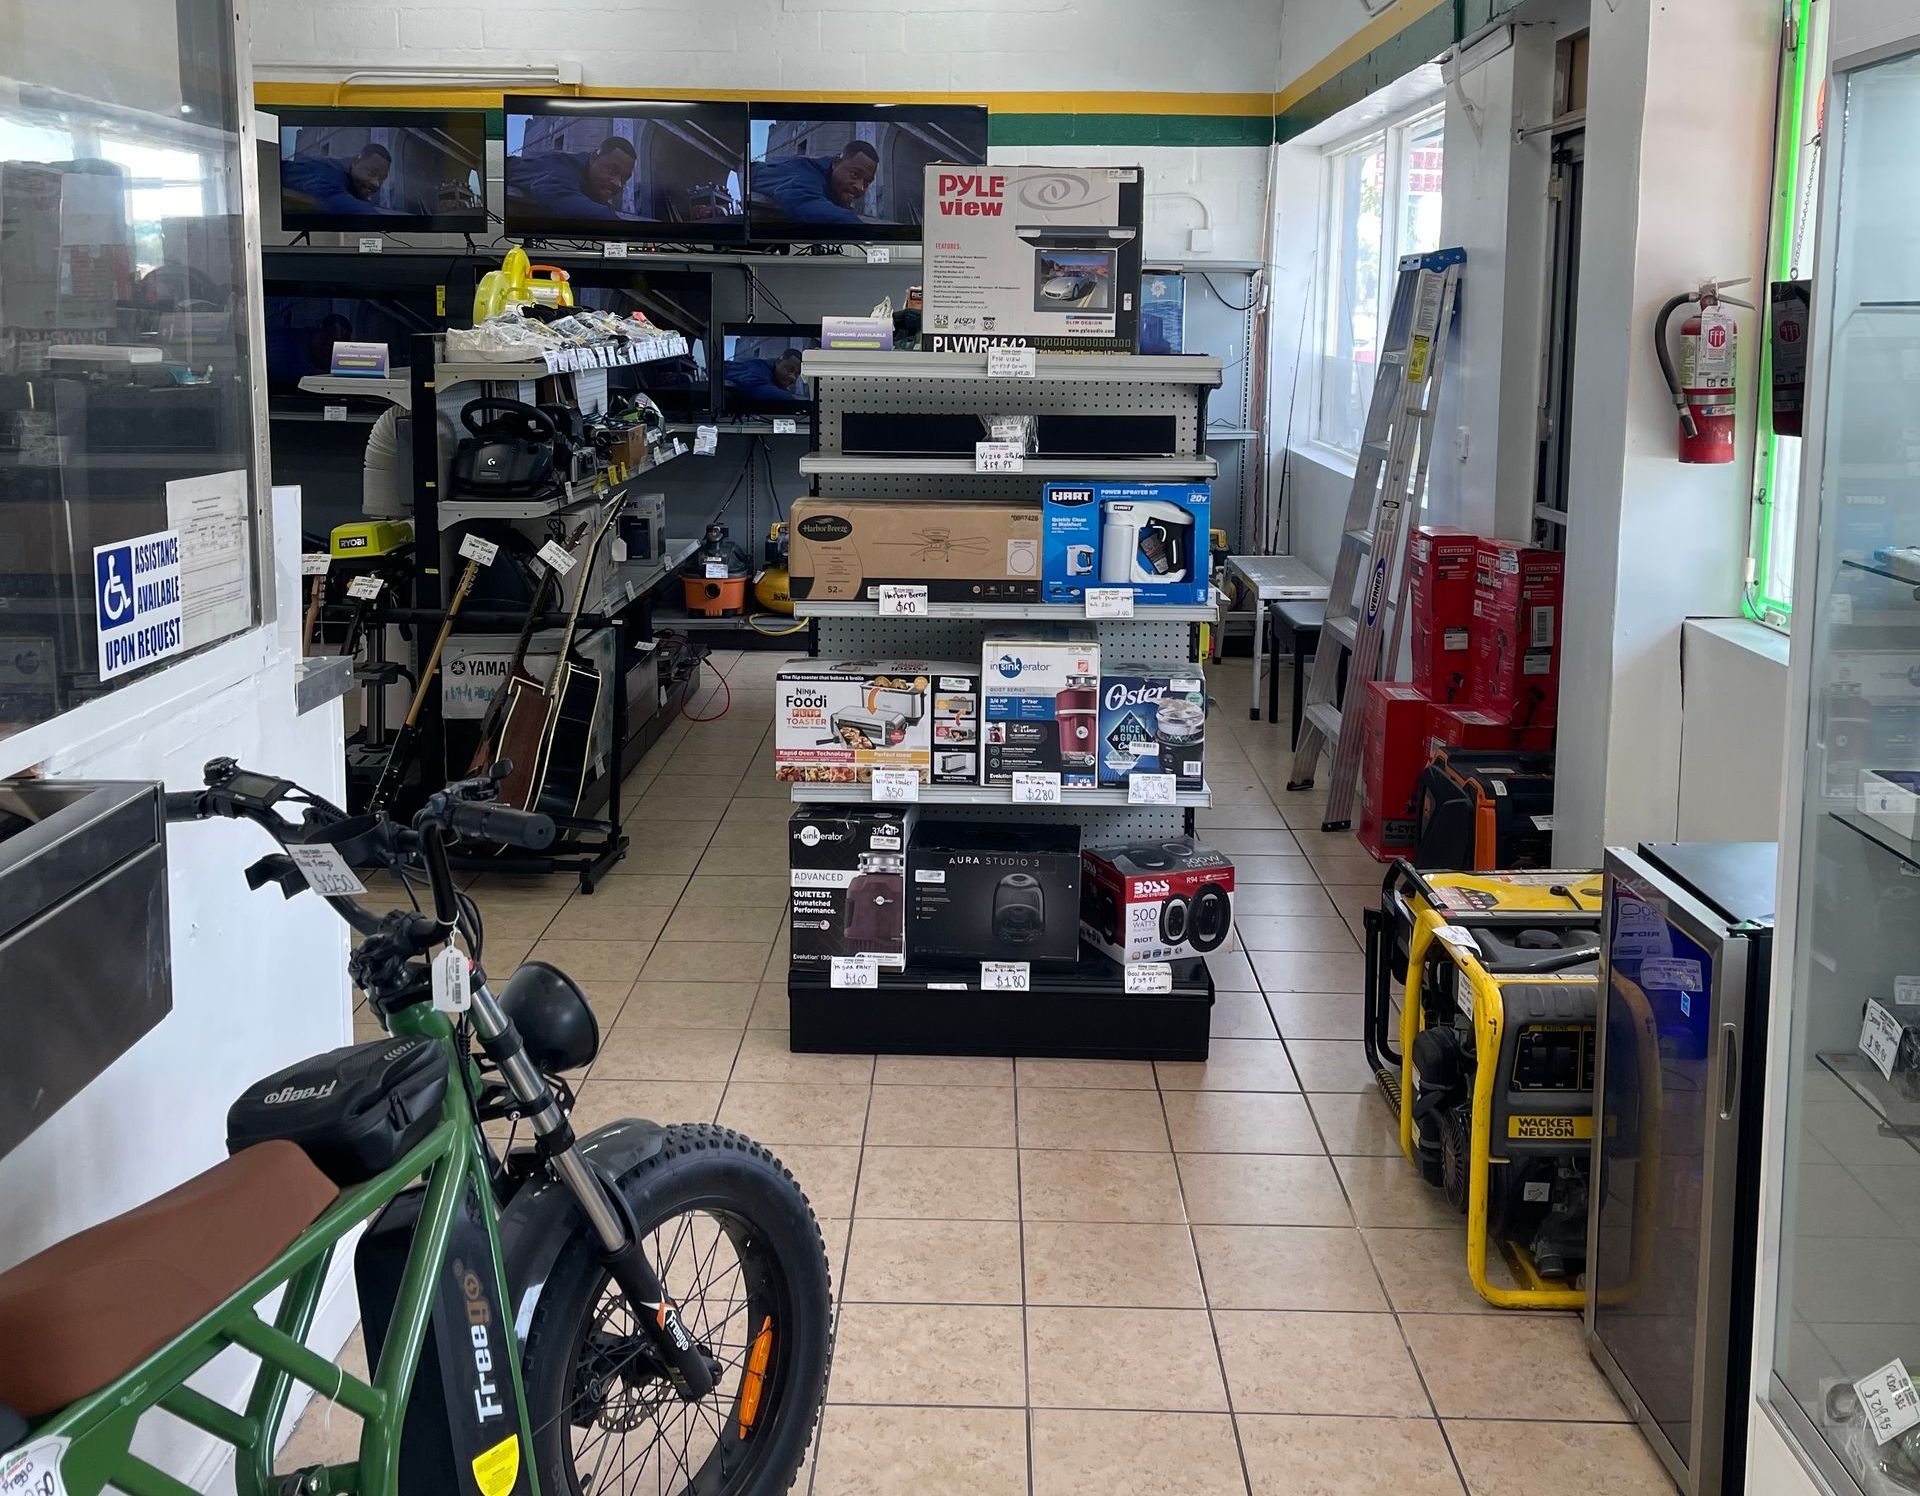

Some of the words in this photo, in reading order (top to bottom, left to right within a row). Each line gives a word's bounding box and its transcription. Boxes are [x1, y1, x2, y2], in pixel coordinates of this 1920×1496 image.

[939, 175, 1004, 197] PYLE
[939, 199, 1003, 216] view
[1710, 330, 1724, 345] FFP
[1051, 491, 1090, 501] HART
[802, 523, 827, 533] Harbor
[827, 524, 848, 533] Breeze
[341, 538, 365, 547] RYOBI
[135, 537, 179, 574] ASSISTANCE
[138, 575, 180, 614] AVAILABLE
[1370, 571, 1383, 612] WERNER
[106, 633, 135, 671] UPON
[137, 617, 181, 660] REQUEST
[786, 695, 827, 708] Foodi
[1105, 684, 1167, 711] Oster
[1120, 725, 1140, 733] RICE
[1120, 733, 1147, 742] GRAIN
[886, 787, 904, 797] $50
[1026, 788, 1054, 801] $280
[949, 856, 980, 864] AURA
[985, 857, 1028, 866] STUDIO
[794, 872, 844, 881] ADVANCED
[1134, 880, 1170, 895] BOSS
[793, 891, 832, 899] QUIETEST.
[793, 907, 836, 915] Performance.
[1133, 908, 1157, 922] 500
[995, 975, 1026, 988] $180
[264, 1079, 338, 1105] Freego
[1518, 1118, 1574, 1127] WACKER
[1518, 1127, 1575, 1137] NEUSON
[666, 1310, 690, 1351] Freego
[462, 1271, 504, 1424] Freego
